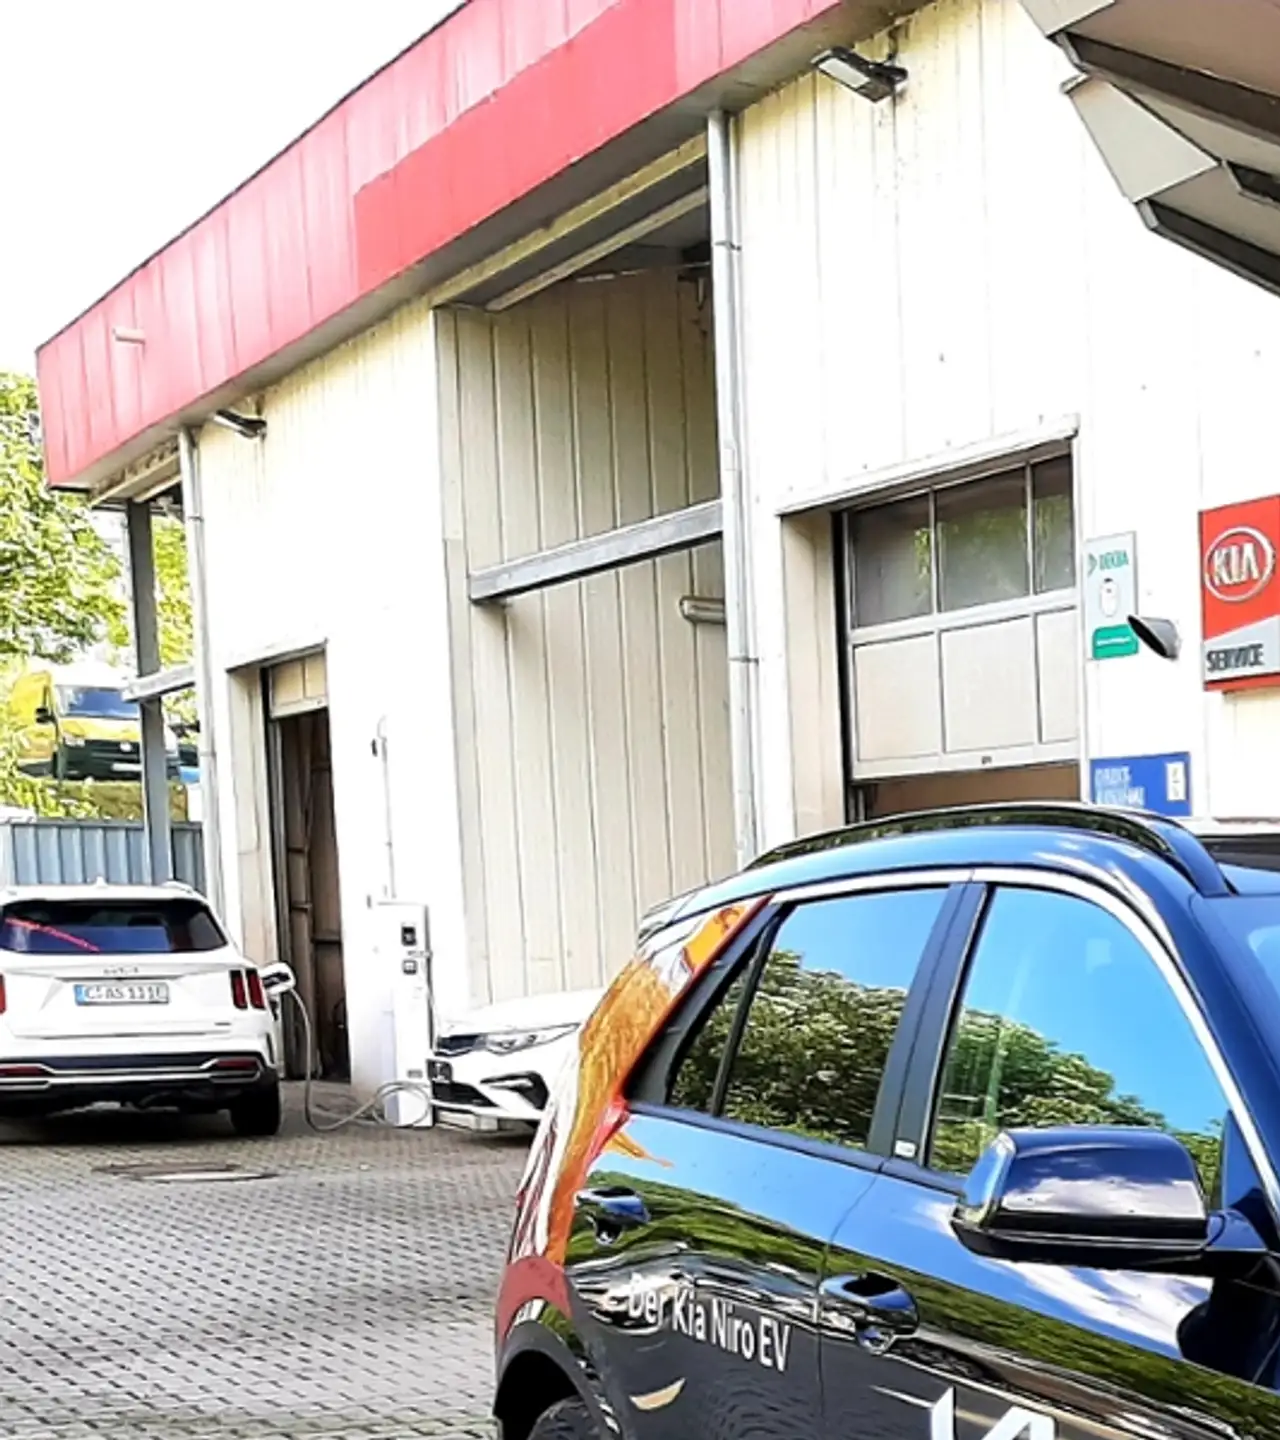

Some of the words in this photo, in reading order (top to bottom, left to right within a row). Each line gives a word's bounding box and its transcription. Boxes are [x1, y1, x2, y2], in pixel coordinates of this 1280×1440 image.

[1213, 543, 1259, 587] KIA
[1206, 643, 1264, 672] SERVICE
[628, 1286, 666, 1327] Der
[672, 1286, 707, 1342] Kia
[712, 1298, 756, 1361] Niro
[759, 1315, 791, 1373] EV
